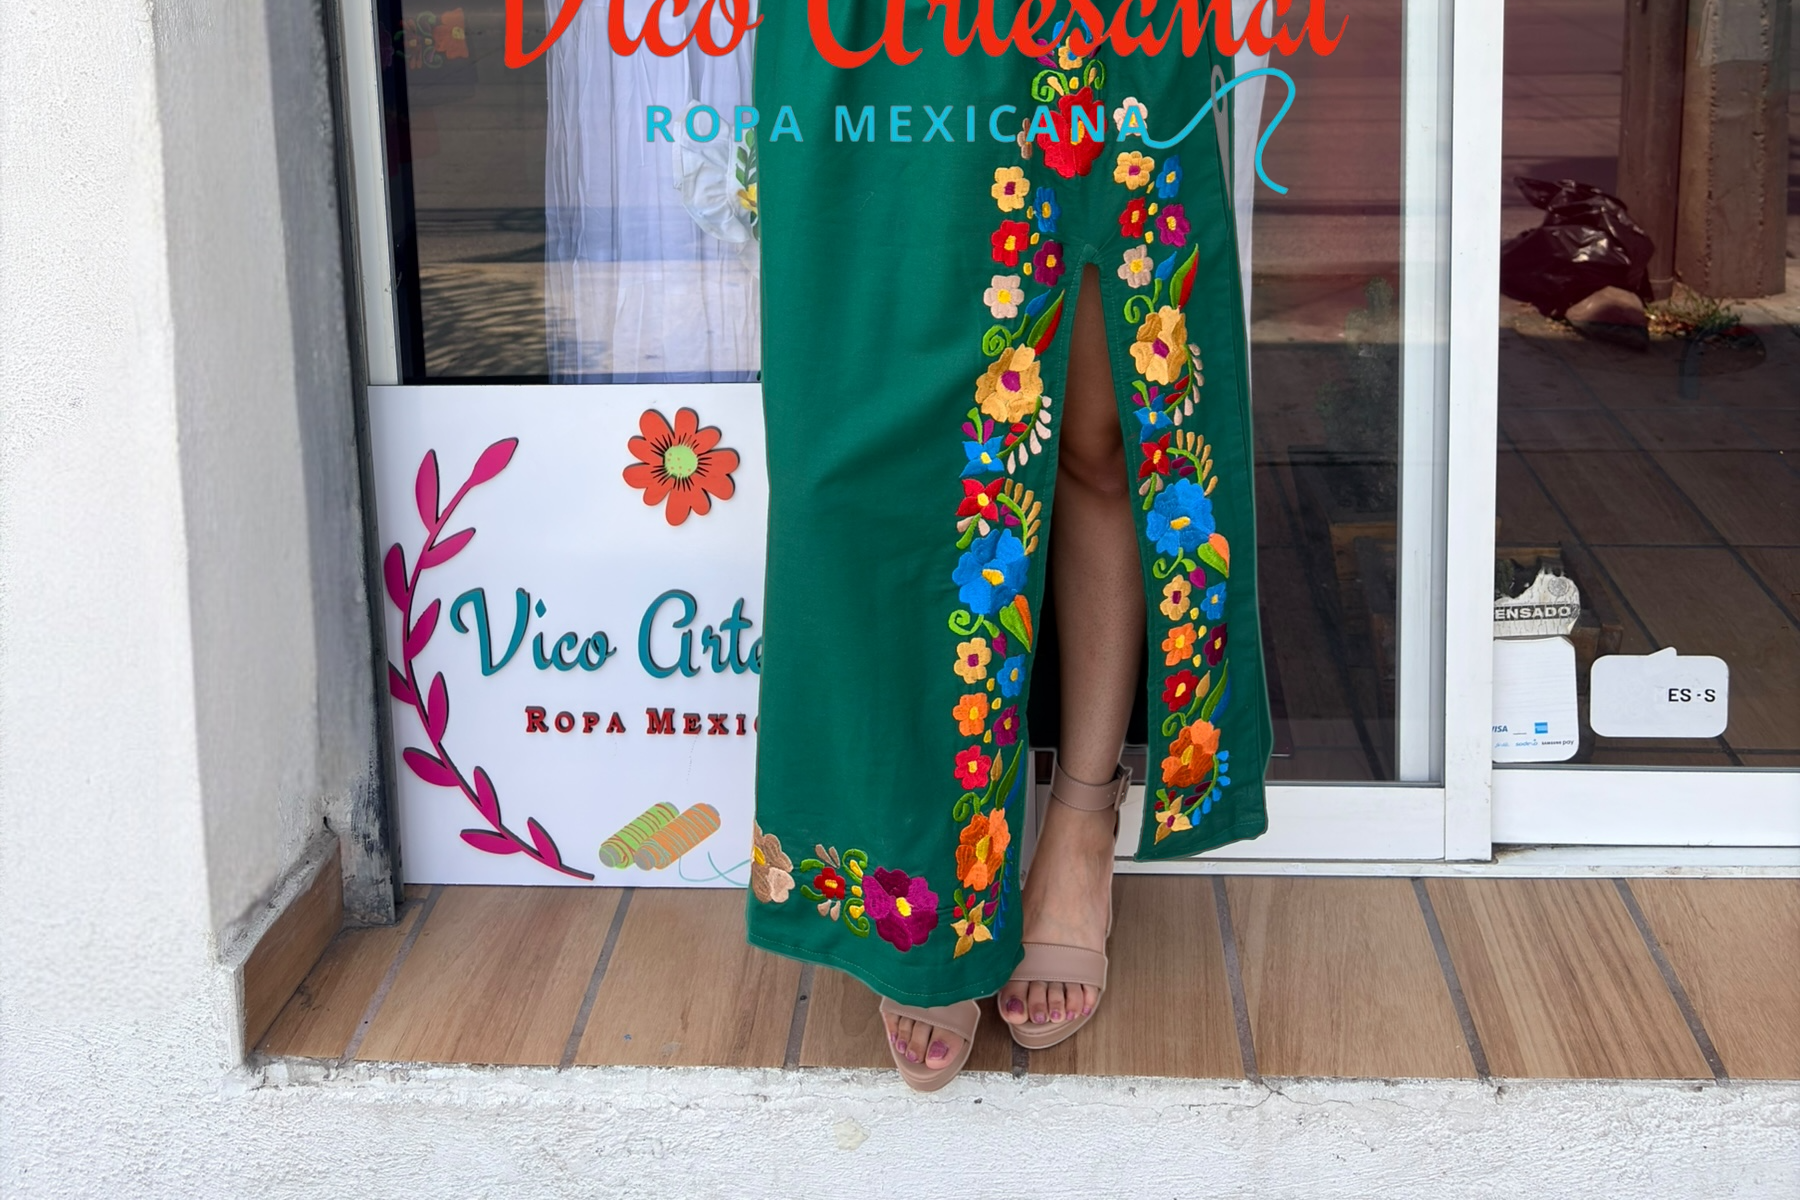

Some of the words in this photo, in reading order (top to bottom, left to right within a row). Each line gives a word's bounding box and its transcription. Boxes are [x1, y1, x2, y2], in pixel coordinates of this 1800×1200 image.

[449, 587, 617, 677] Vico
[1668, 687, 1692, 703] ES
[1704, 688, 1717, 703] S
[525, 705, 627, 734] ROPA
[645, 707, 758, 736] MEXI
